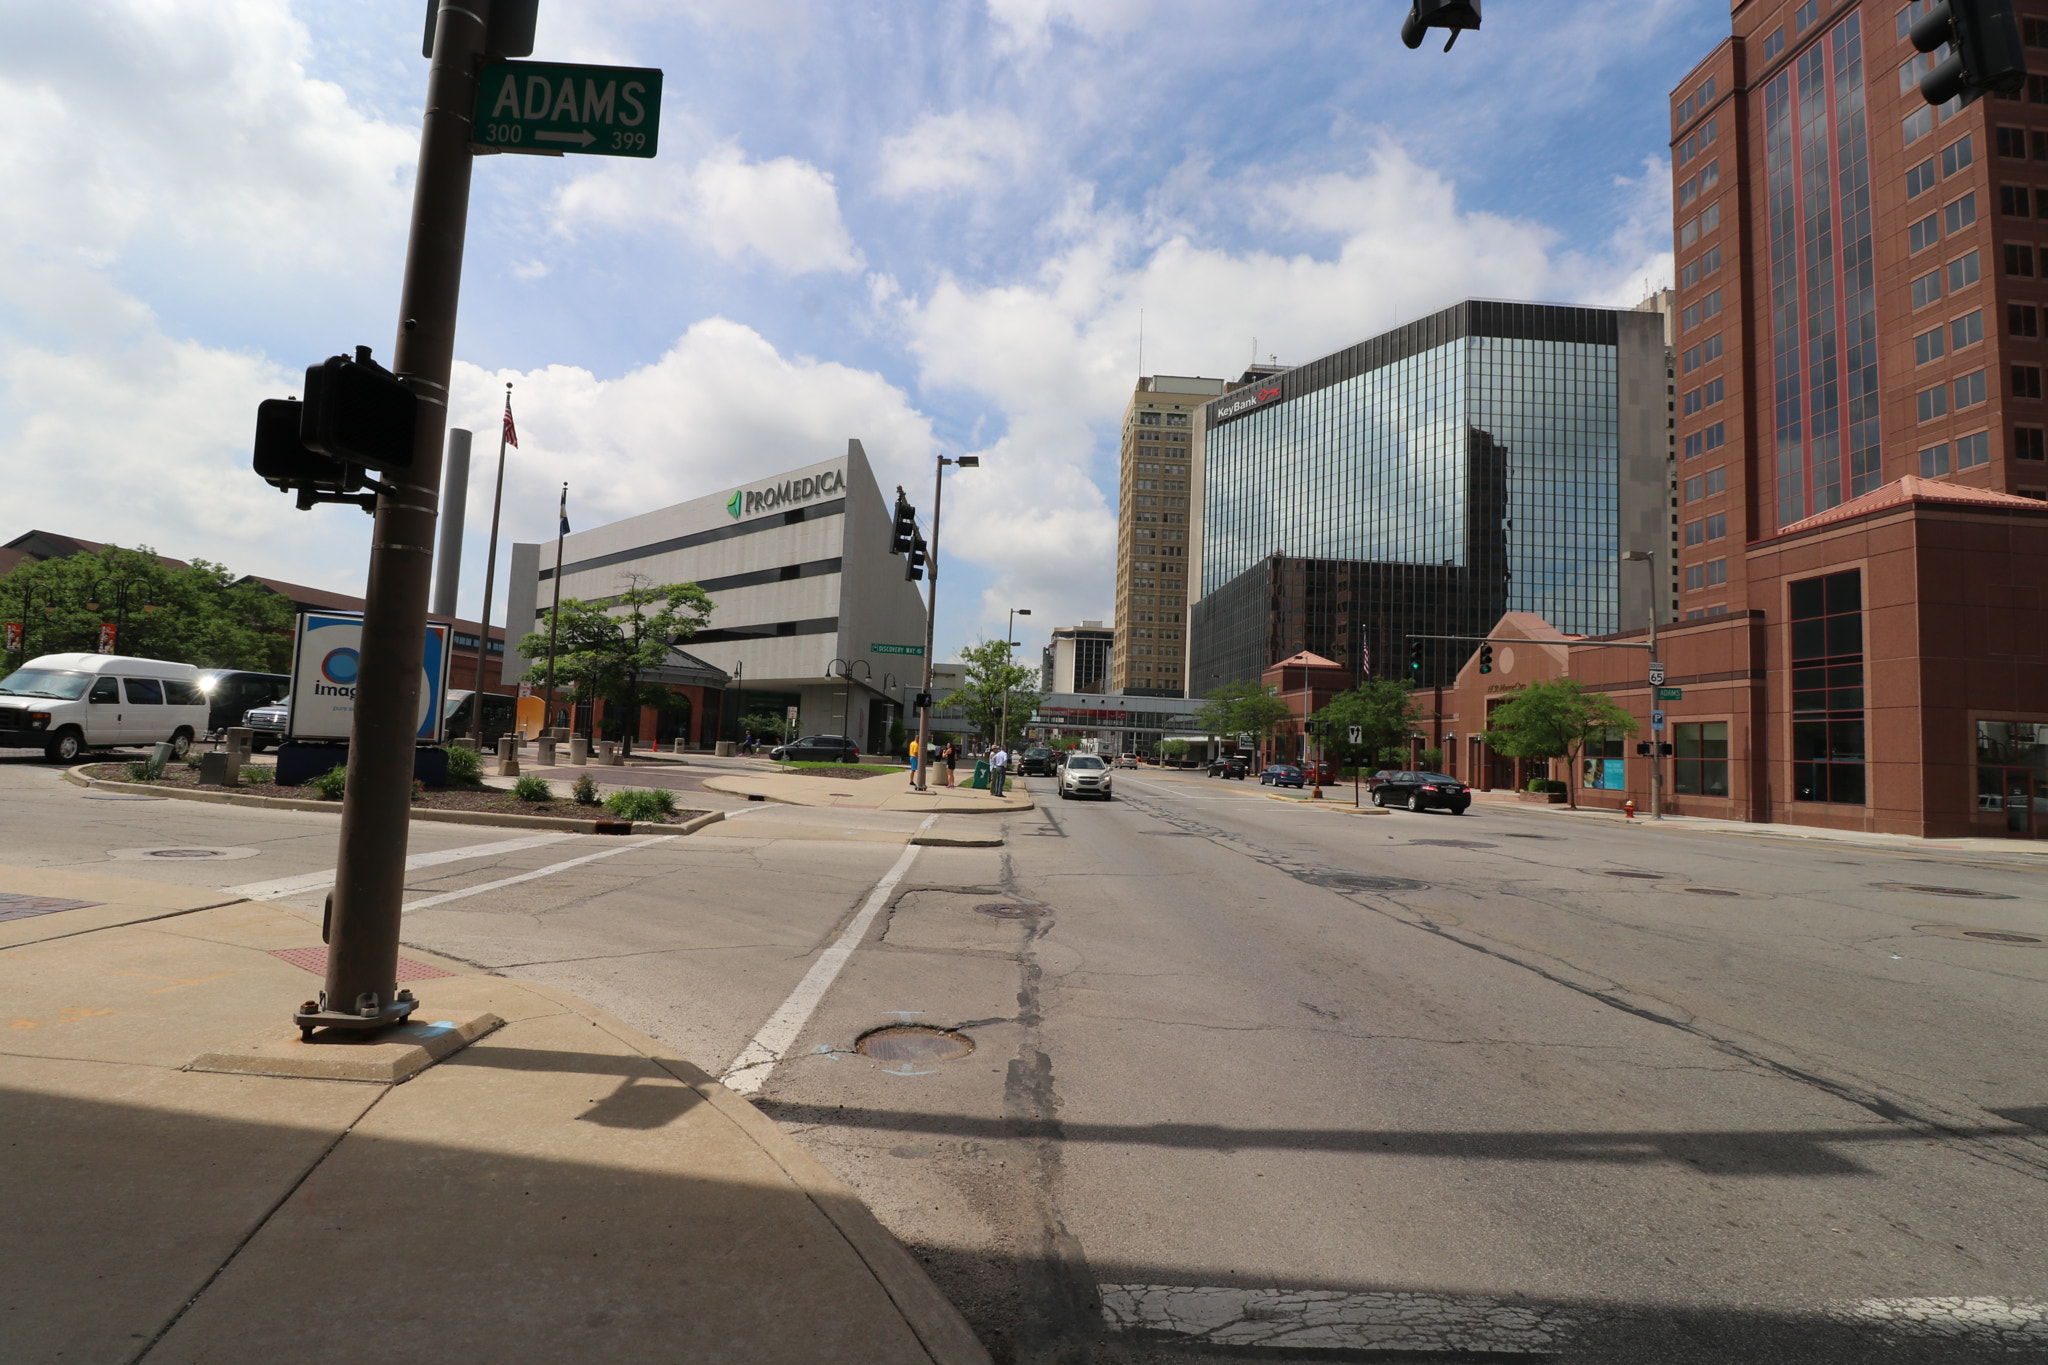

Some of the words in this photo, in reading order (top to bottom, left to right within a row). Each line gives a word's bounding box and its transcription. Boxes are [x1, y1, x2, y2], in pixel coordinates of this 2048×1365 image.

[492, 74, 646, 127] ADAMS
[485, 124, 522, 143] 300
[611, 132, 646, 151] 399
[1218, 396, 1257, 418] KeyBank
[878, 645, 904, 653] DISCOVERY
[1651, 673, 1663, 682] 65
[1660, 689, 1681, 697] ADAMS
[1655, 714, 1661, 722] P
